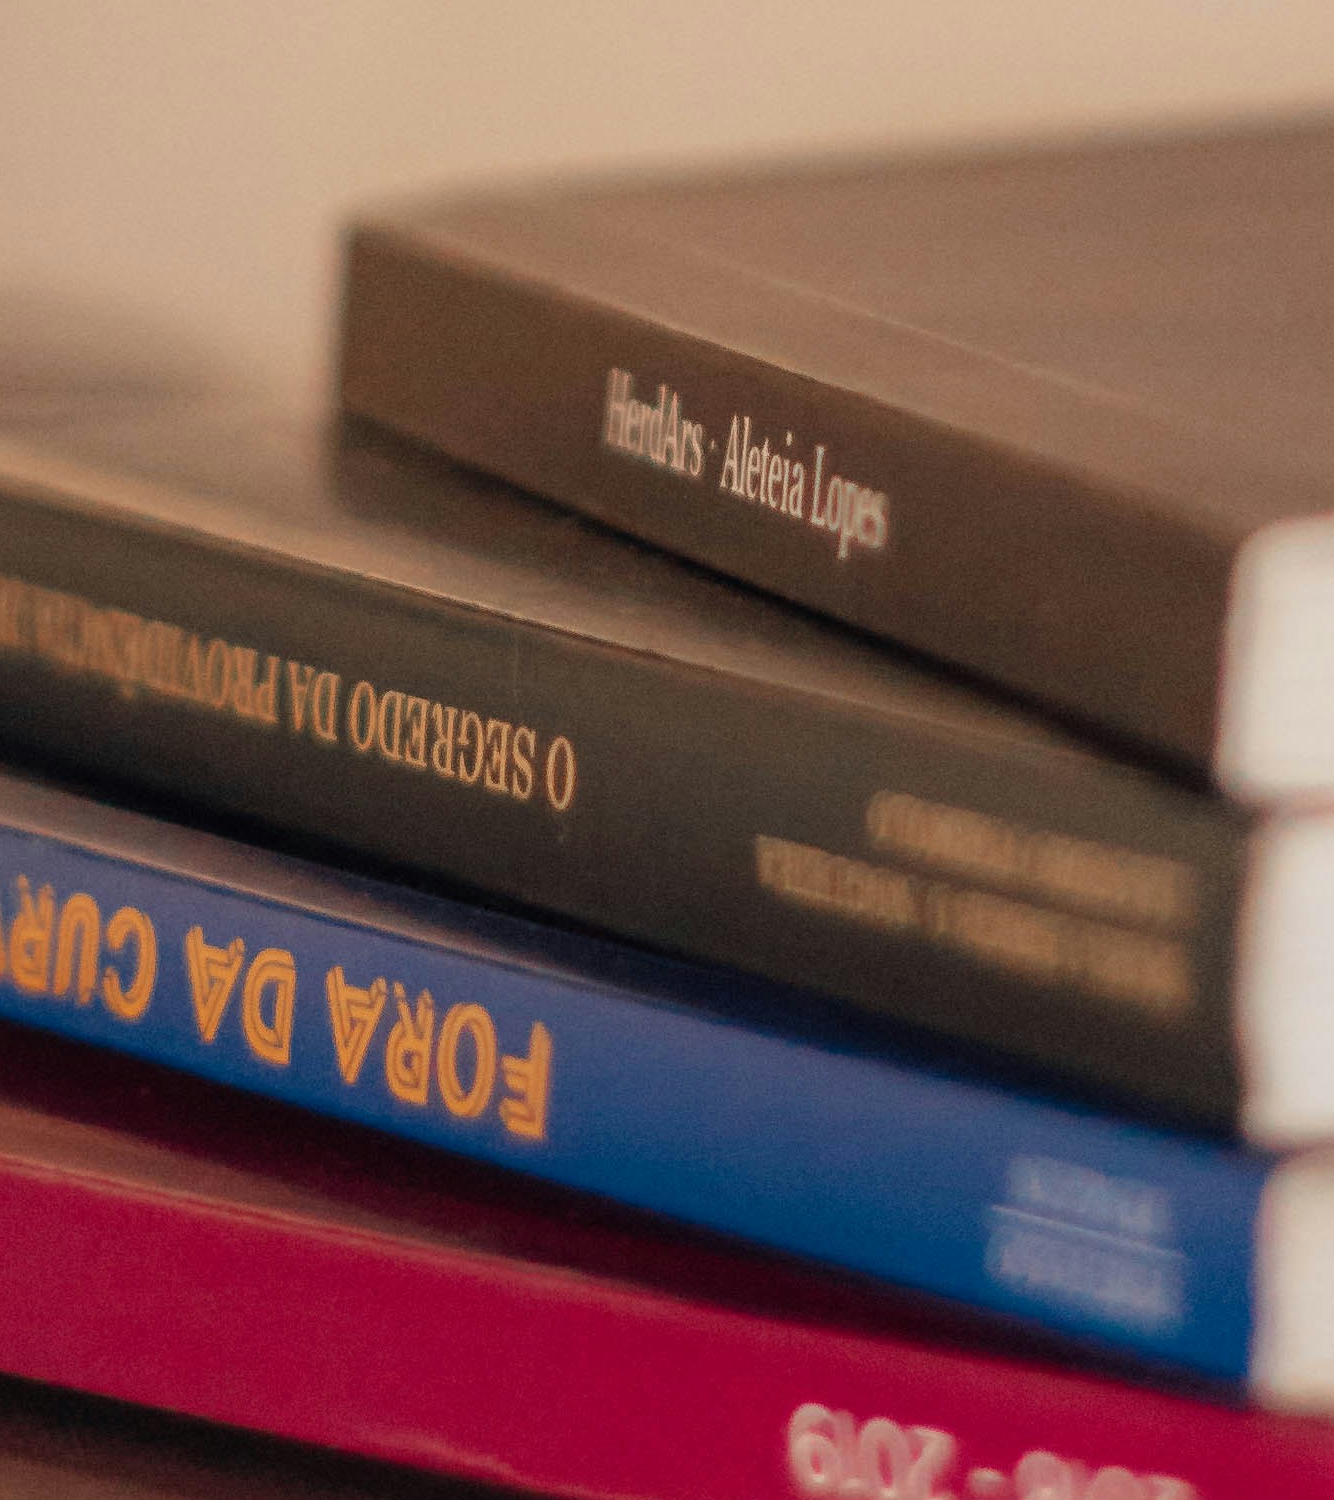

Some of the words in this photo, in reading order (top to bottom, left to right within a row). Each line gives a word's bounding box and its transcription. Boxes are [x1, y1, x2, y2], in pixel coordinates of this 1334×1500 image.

[719, 412, 805, 519] Aleteia
[809, 444, 890, 561] Lopes
[286, 659, 340, 744] DA
[347, 681, 537, 800] SEGREDO
[545, 734, 578, 811] O
[185, 925, 297, 1065] DA
[325, 965, 554, 1142] FORA
